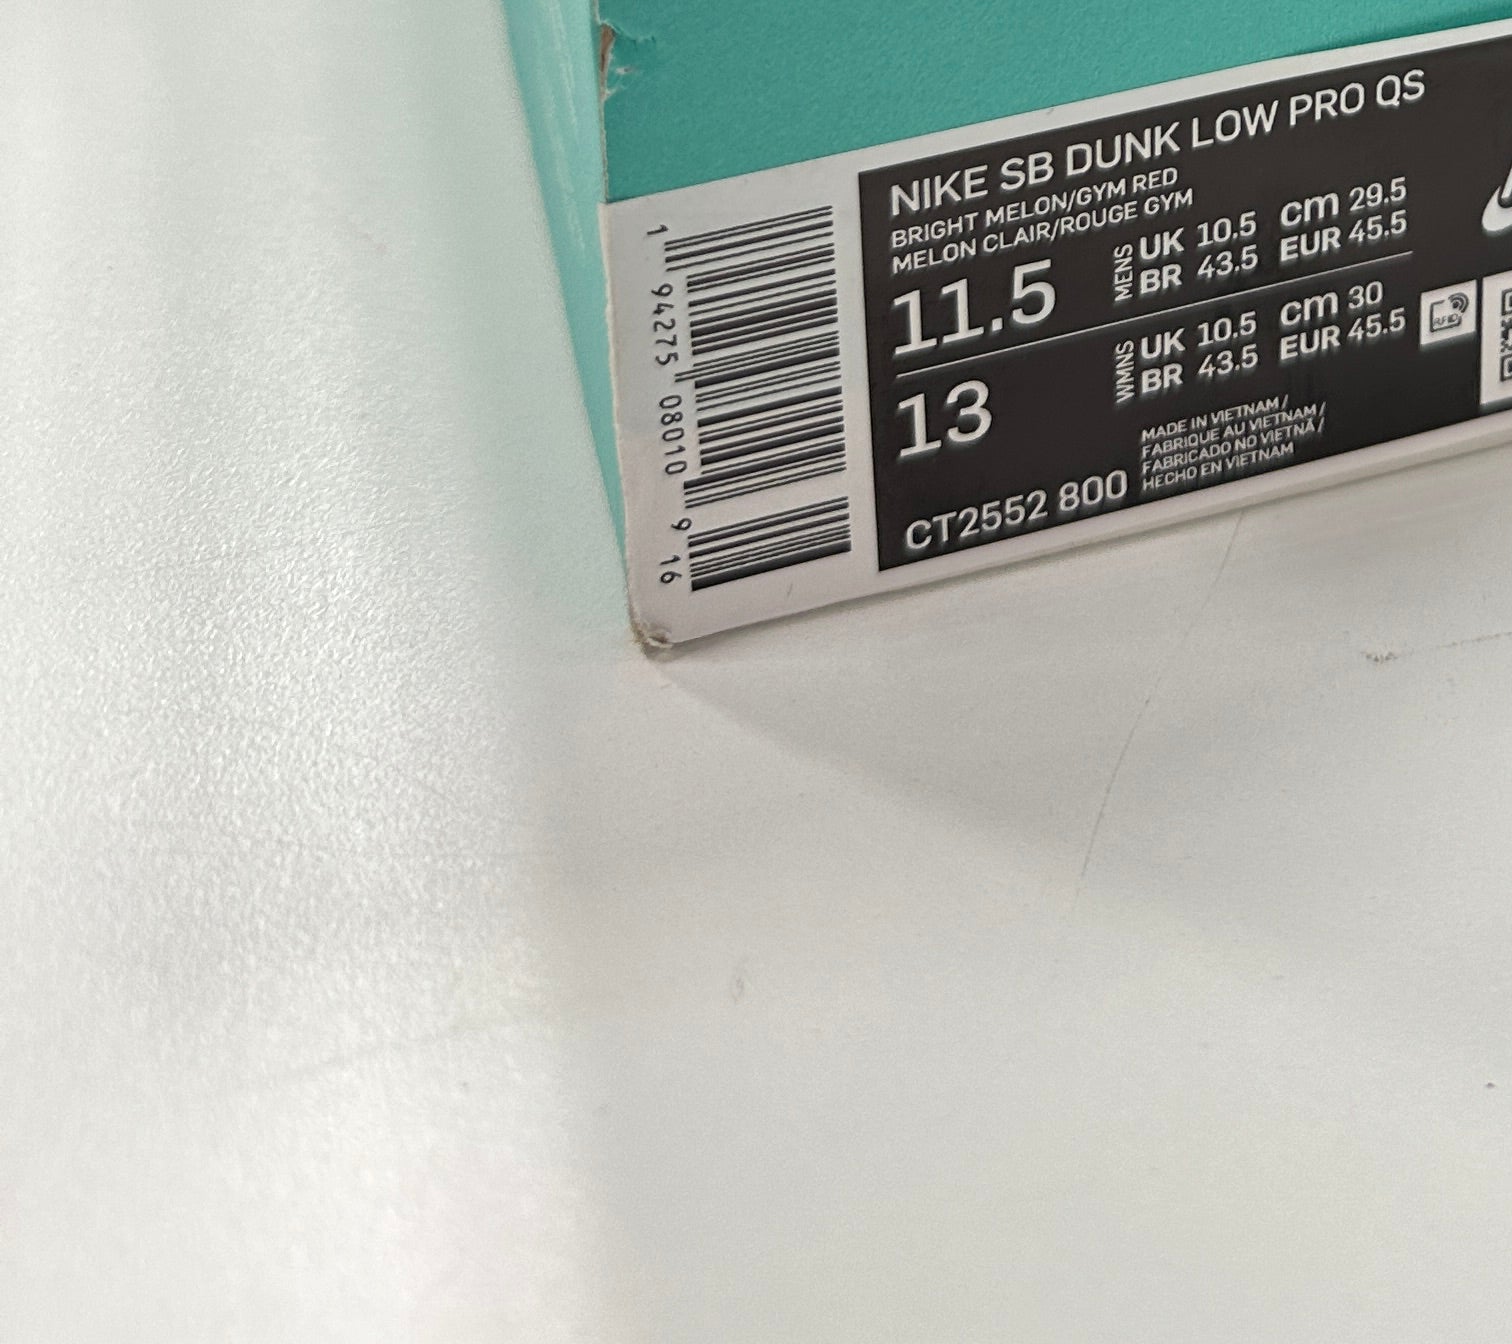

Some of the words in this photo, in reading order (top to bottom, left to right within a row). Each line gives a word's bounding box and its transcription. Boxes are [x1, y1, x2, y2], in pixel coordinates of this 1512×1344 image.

[891, 165, 989, 216] NIKE
[1000, 151, 1055, 191] SB
[1066, 121, 1181, 176] DUNK
[1191, 100, 1279, 148] LOW
[1289, 82, 1366, 126] PRO
[1375, 68, 1426, 107] QS
[646, 223, 669, 236] 1
[891, 212, 978, 249] BRIGHT
[985, 178, 1126, 228] MELON/GYM
[1132, 167, 1179, 194] RED
[892, 238, 977, 274] MELON
[982, 200, 1138, 252] CLAIR/ROUGE
[1143, 188, 1194, 215] GYM
[1139, 227, 1185, 260] UK
[1196, 211, 1257, 247] 10.5
[1280, 192, 1340, 228] cm
[1349, 176, 1407, 211] 29.5
[1113, 243, 1134, 302] MENS
[1139, 262, 1183, 295] BR
[1197, 244, 1259, 279] 43.5
[1280, 226, 1341, 262] EUR
[1348, 210, 1407, 243] 45.5
[651, 282, 680, 366] 94275
[892, 258, 1056, 355] 11.5
[1140, 327, 1186, 360] UK
[1197, 311, 1257, 346] 10.5
[1280, 291, 1339, 327] cm
[1348, 280, 1384, 309] 30
[1114, 340, 1136, 404] WMNS
[1140, 362, 1184, 395] BR
[1197, 344, 1259, 378] 43.5
[1279, 326, 1341, 360] EUR
[1348, 308, 1406, 340] 45.5
[658, 393, 688, 476] 08010
[896, 379, 992, 457] 13
[1141, 419, 1188, 442] MADE
[1191, 414, 1208, 430] IN
[1141, 429, 1220, 458] FABRIQUE
[1223, 421, 1246, 439] AU
[1141, 440, 1232, 474] FABRICADO
[1234, 434, 1258, 452] NO
[1142, 466, 1198, 491] HECHO
[1201, 459, 1223, 476] EN
[1225, 441, 1294, 470] VIETNAM
[671, 517, 692, 532] 9
[905, 489, 1049, 551] CT2552
[1058, 469, 1129, 512] 800
